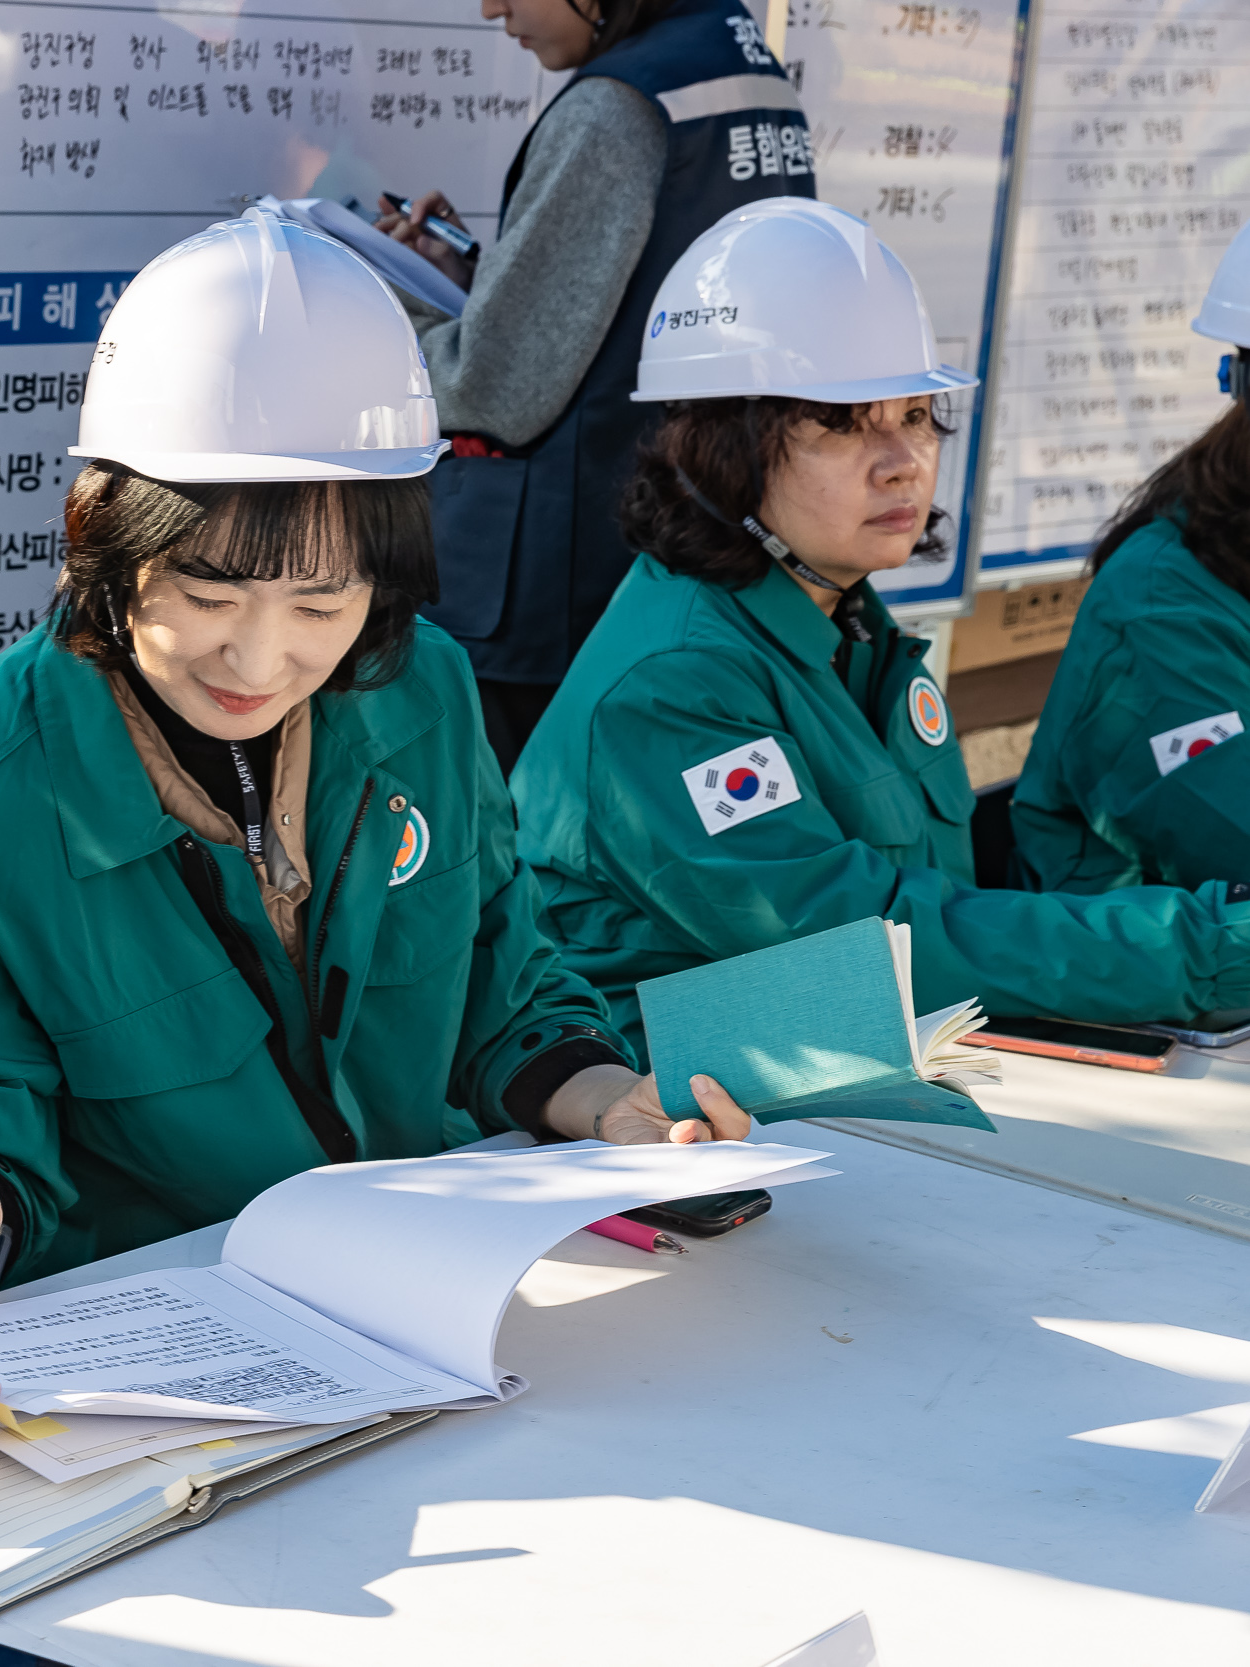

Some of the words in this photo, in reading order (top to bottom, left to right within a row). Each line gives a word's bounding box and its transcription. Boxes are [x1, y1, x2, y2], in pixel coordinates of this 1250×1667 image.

[21, 31, 96, 70] 광진구청
[130, 33, 167, 72] 청사
[113, 83, 129, 123] 및
[668, 306, 738, 330] 광진구청
